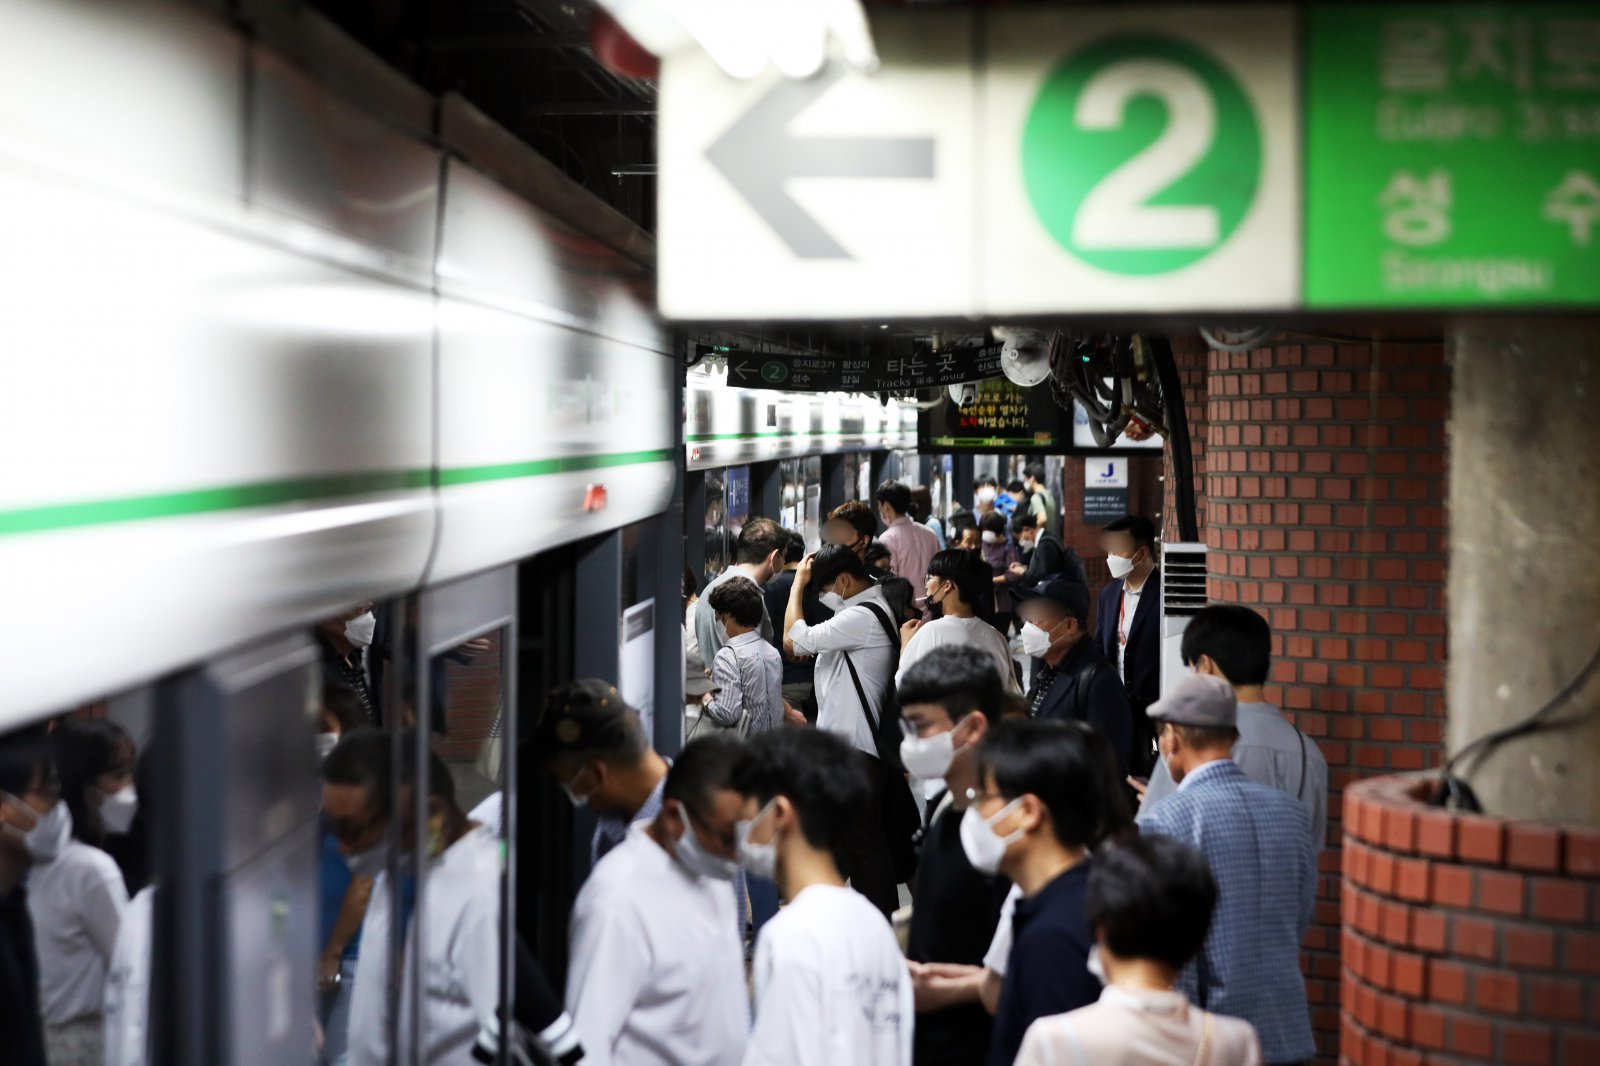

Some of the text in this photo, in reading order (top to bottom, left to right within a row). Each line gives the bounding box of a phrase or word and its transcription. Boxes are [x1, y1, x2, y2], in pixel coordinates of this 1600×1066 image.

[1073, 62, 1223, 253] 2
[769, 365, 780, 379] 2
[887, 357, 928, 376] 타는
[876, 378, 911, 388] Tracks
